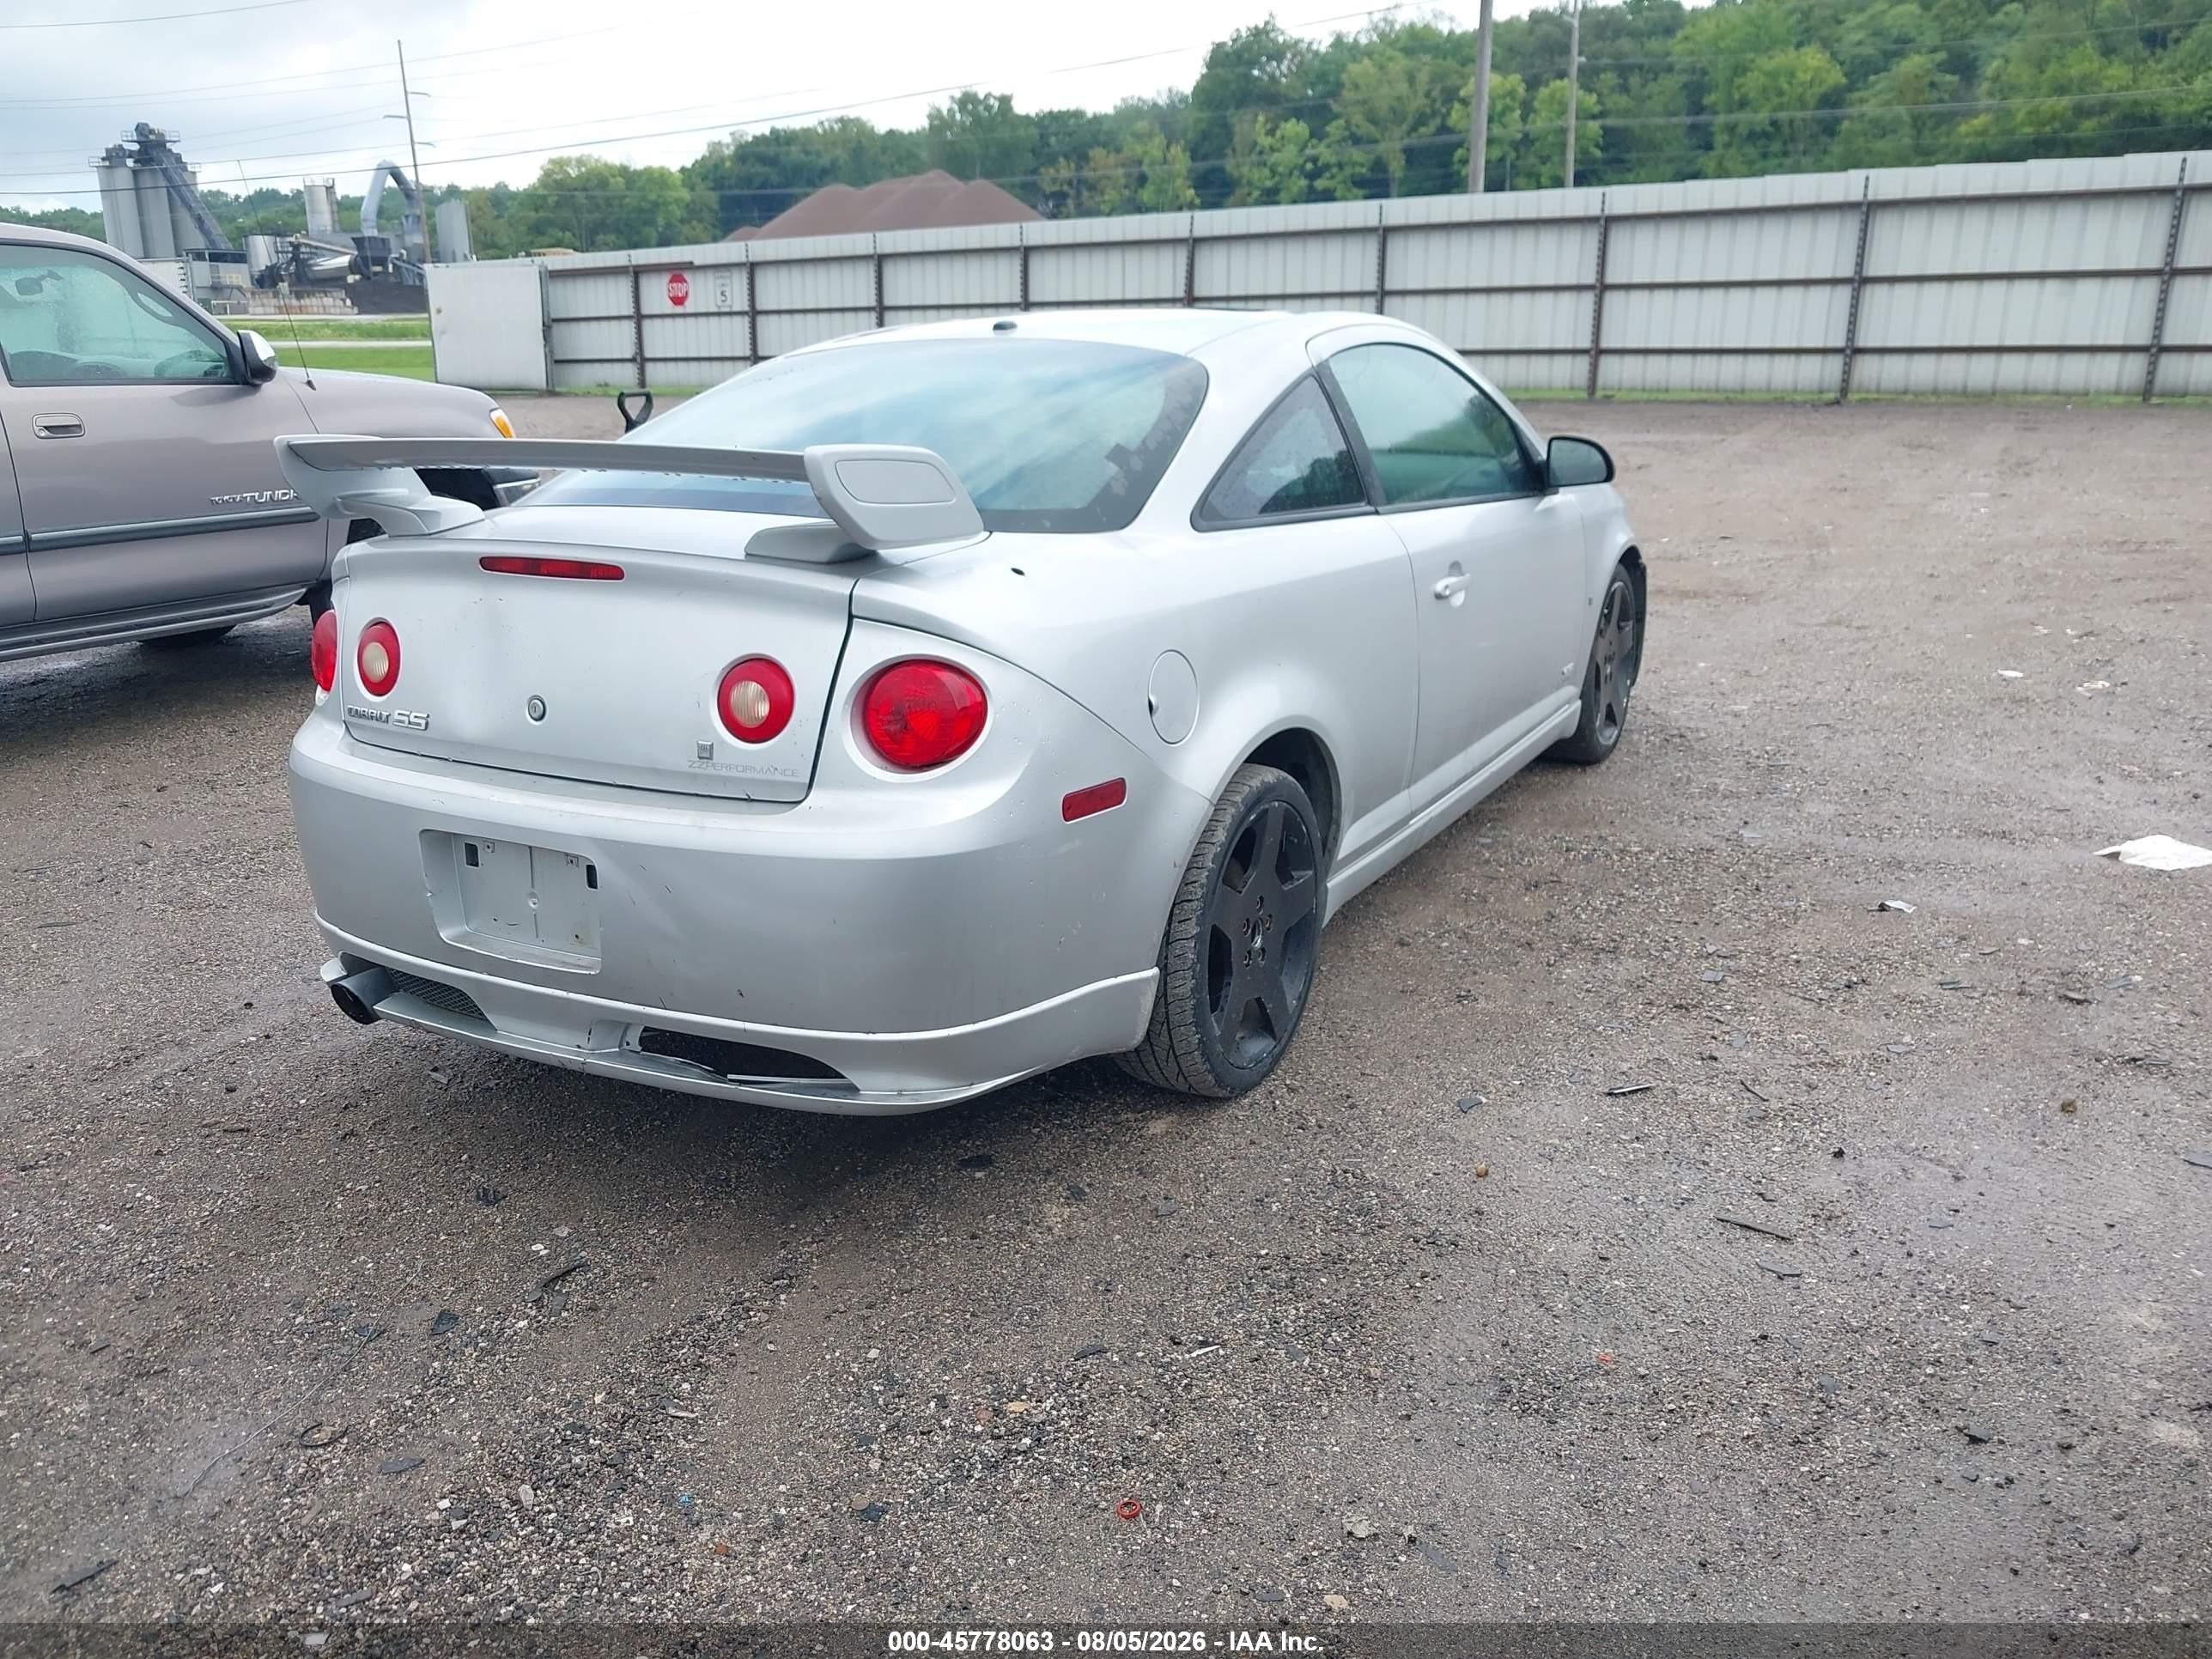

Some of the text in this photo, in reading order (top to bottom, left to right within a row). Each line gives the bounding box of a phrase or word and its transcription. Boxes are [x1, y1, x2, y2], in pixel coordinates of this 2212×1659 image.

[669, 282, 689, 297] STOP
[720, 289, 728, 302] 5
[392, 709, 430, 731] SS
[687, 759, 800, 777] ZZPERFORMANCE
